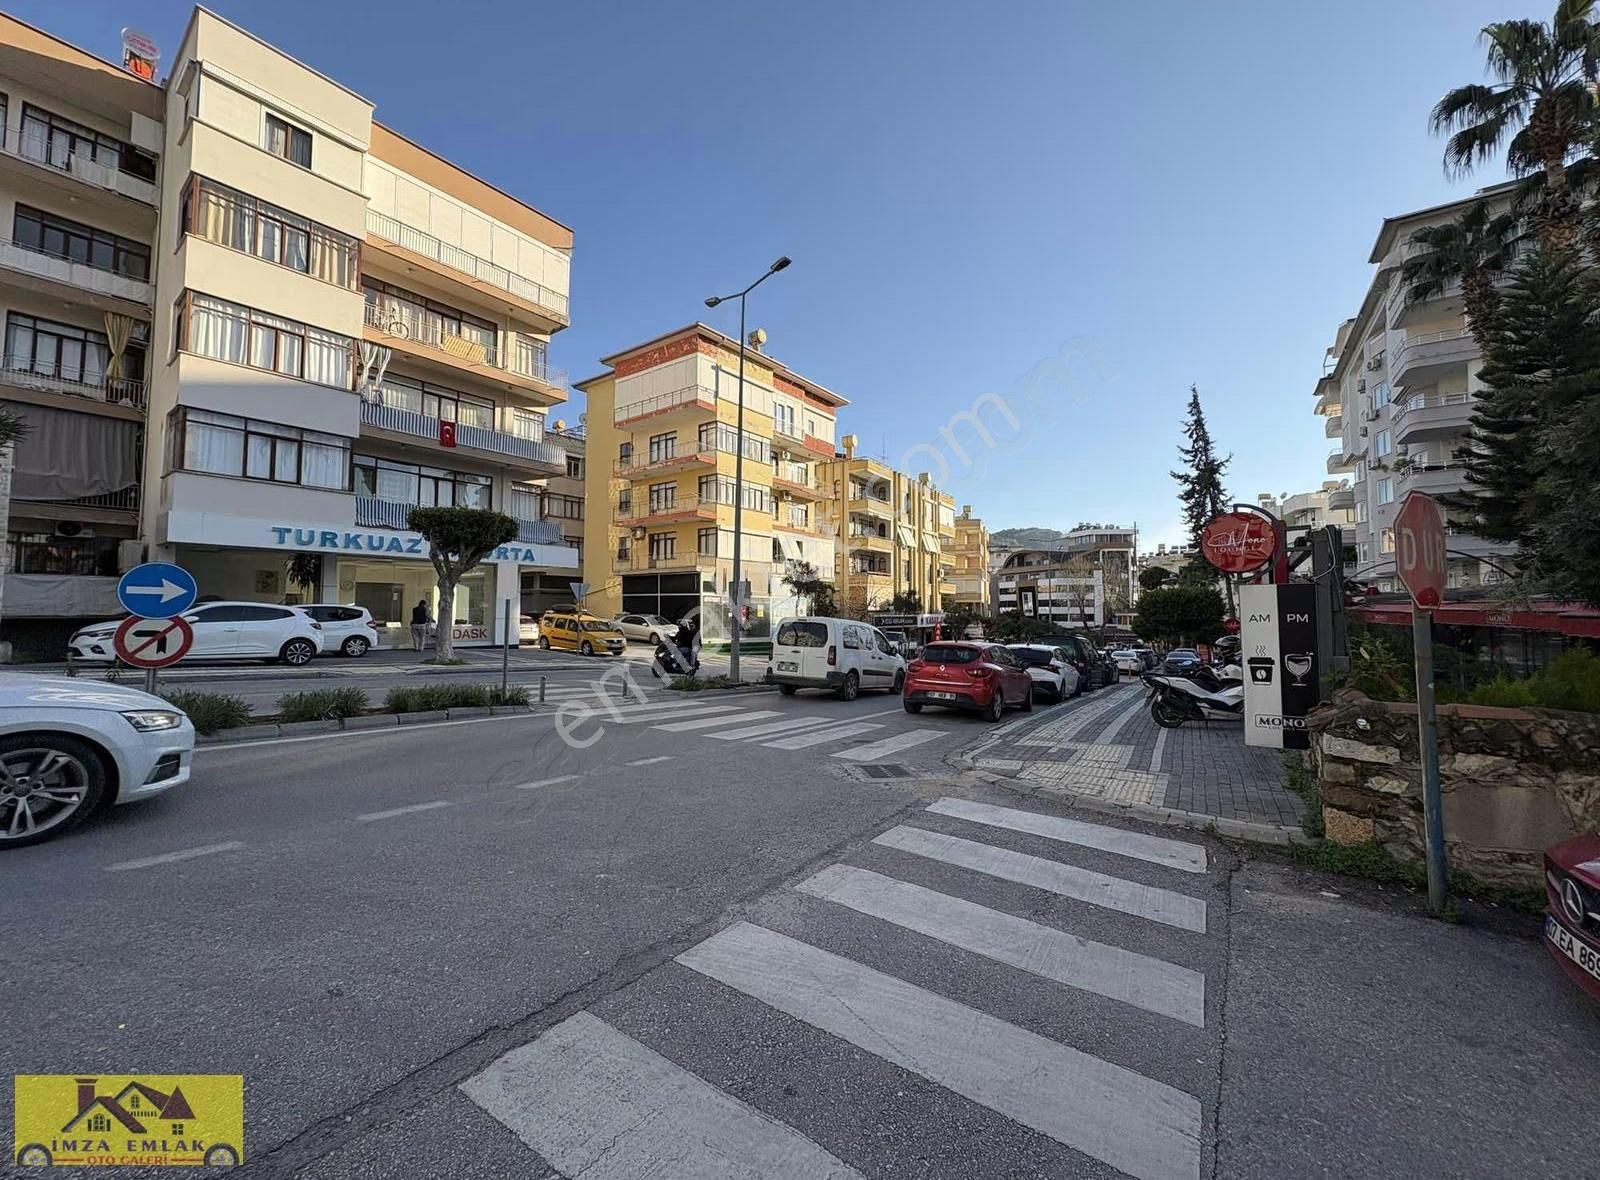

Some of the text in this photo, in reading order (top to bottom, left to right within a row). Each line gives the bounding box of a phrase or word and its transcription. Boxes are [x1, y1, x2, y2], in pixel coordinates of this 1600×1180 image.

[271, 526, 423, 554] TURKUAZ
[1249, 614, 1271, 623] AM
[1286, 613, 1309, 623] PM
[452, 628, 488, 640] DASK
[1258, 717, 1305, 728] MONO
[1560, 929, 1574, 958] EA
